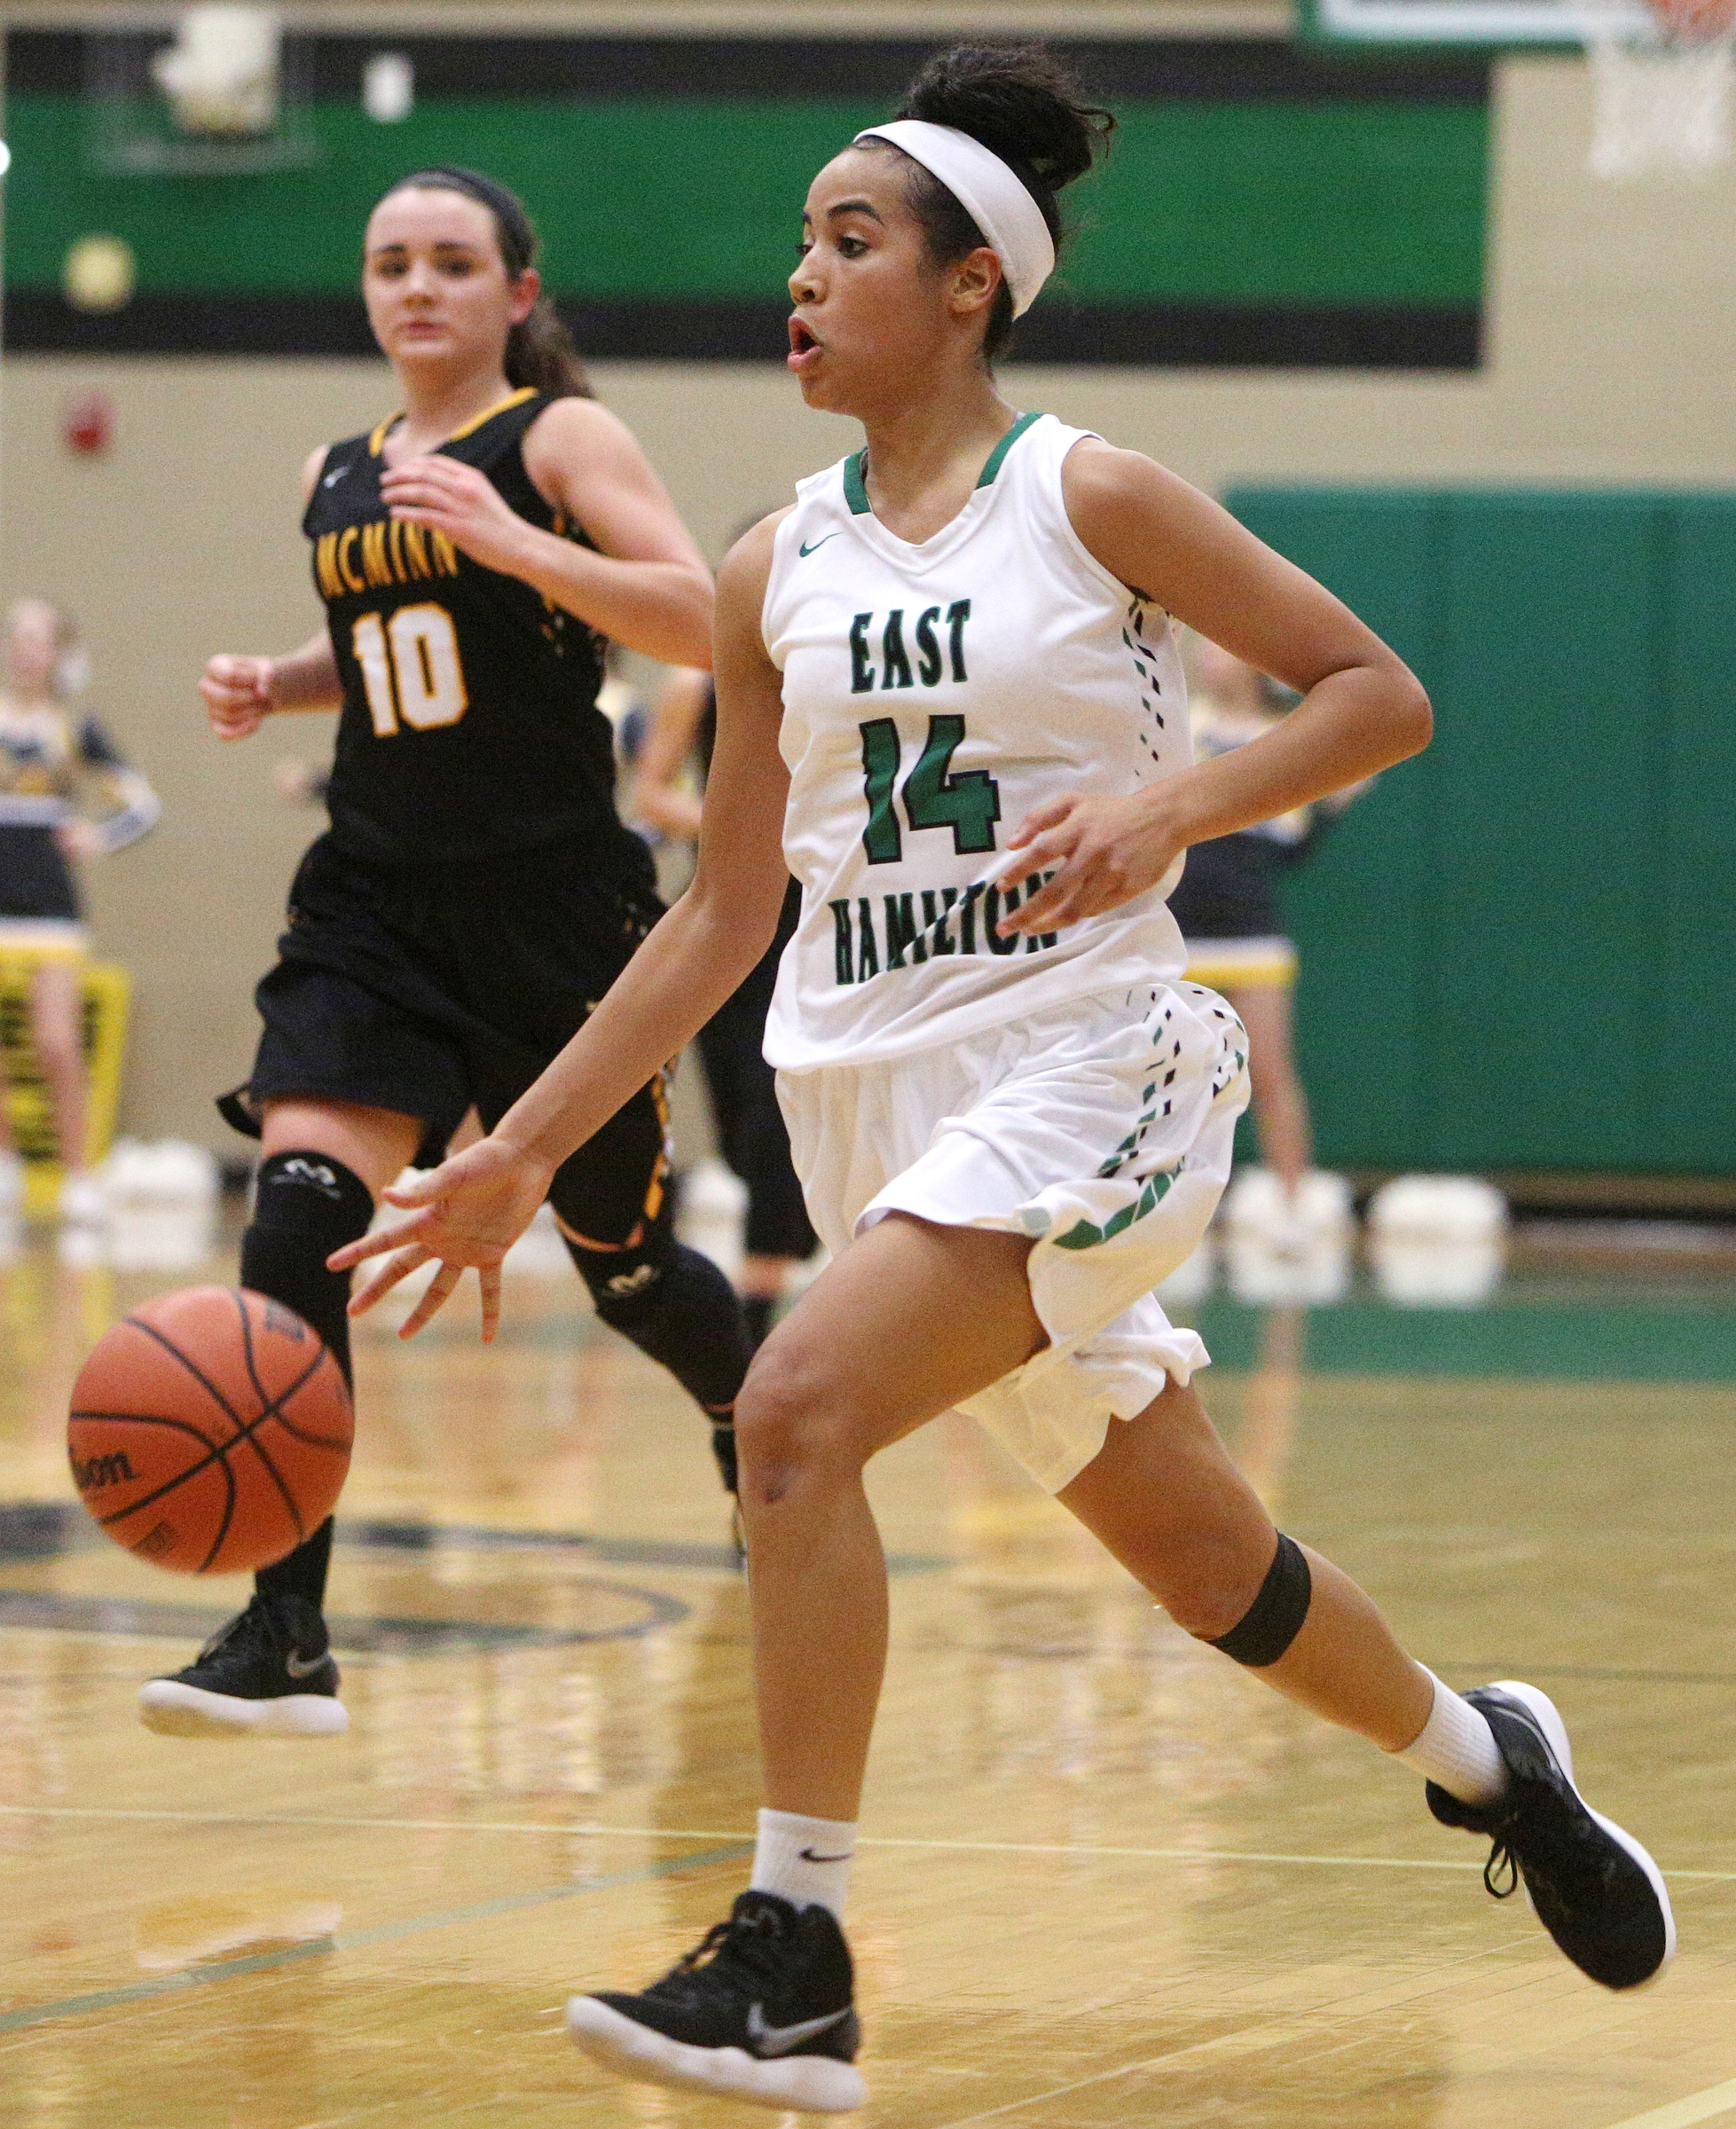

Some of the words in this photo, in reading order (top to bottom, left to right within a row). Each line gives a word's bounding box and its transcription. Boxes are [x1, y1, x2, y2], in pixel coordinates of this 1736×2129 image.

[352, 601, 468, 736] 10
[849, 599, 971, 693] EAST
[859, 714, 1002, 865] 14
